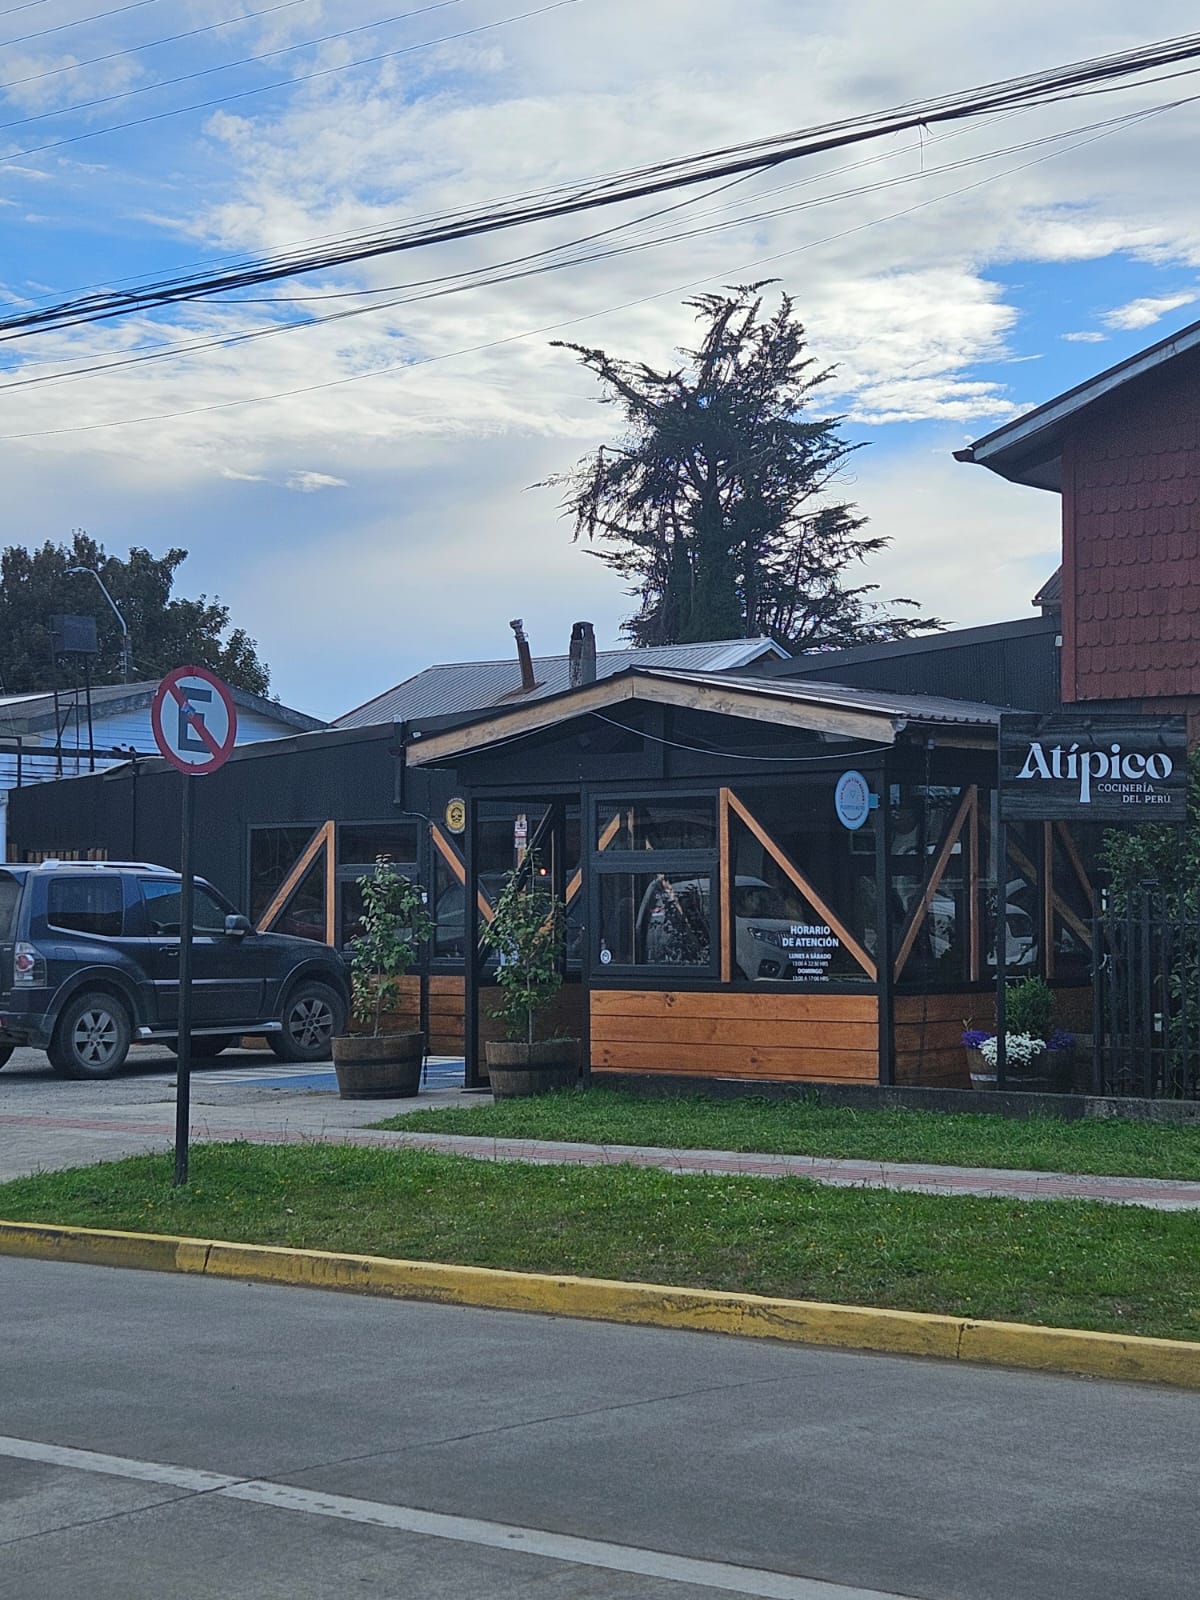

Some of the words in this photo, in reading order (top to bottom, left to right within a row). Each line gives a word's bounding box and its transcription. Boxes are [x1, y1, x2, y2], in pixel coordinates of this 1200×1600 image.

[178, 686, 213, 754] E
[1015, 742, 1173, 803] Atípico
[1097, 781, 1155, 793] COCINERÍA
[1122, 794, 1142, 803] DEL
[1144, 793, 1171, 804] PERÚ
[790, 925, 831, 935] HORARIO
[782, 937, 795, 947] DE
[795, 936, 839, 947] ATENCIÓN
